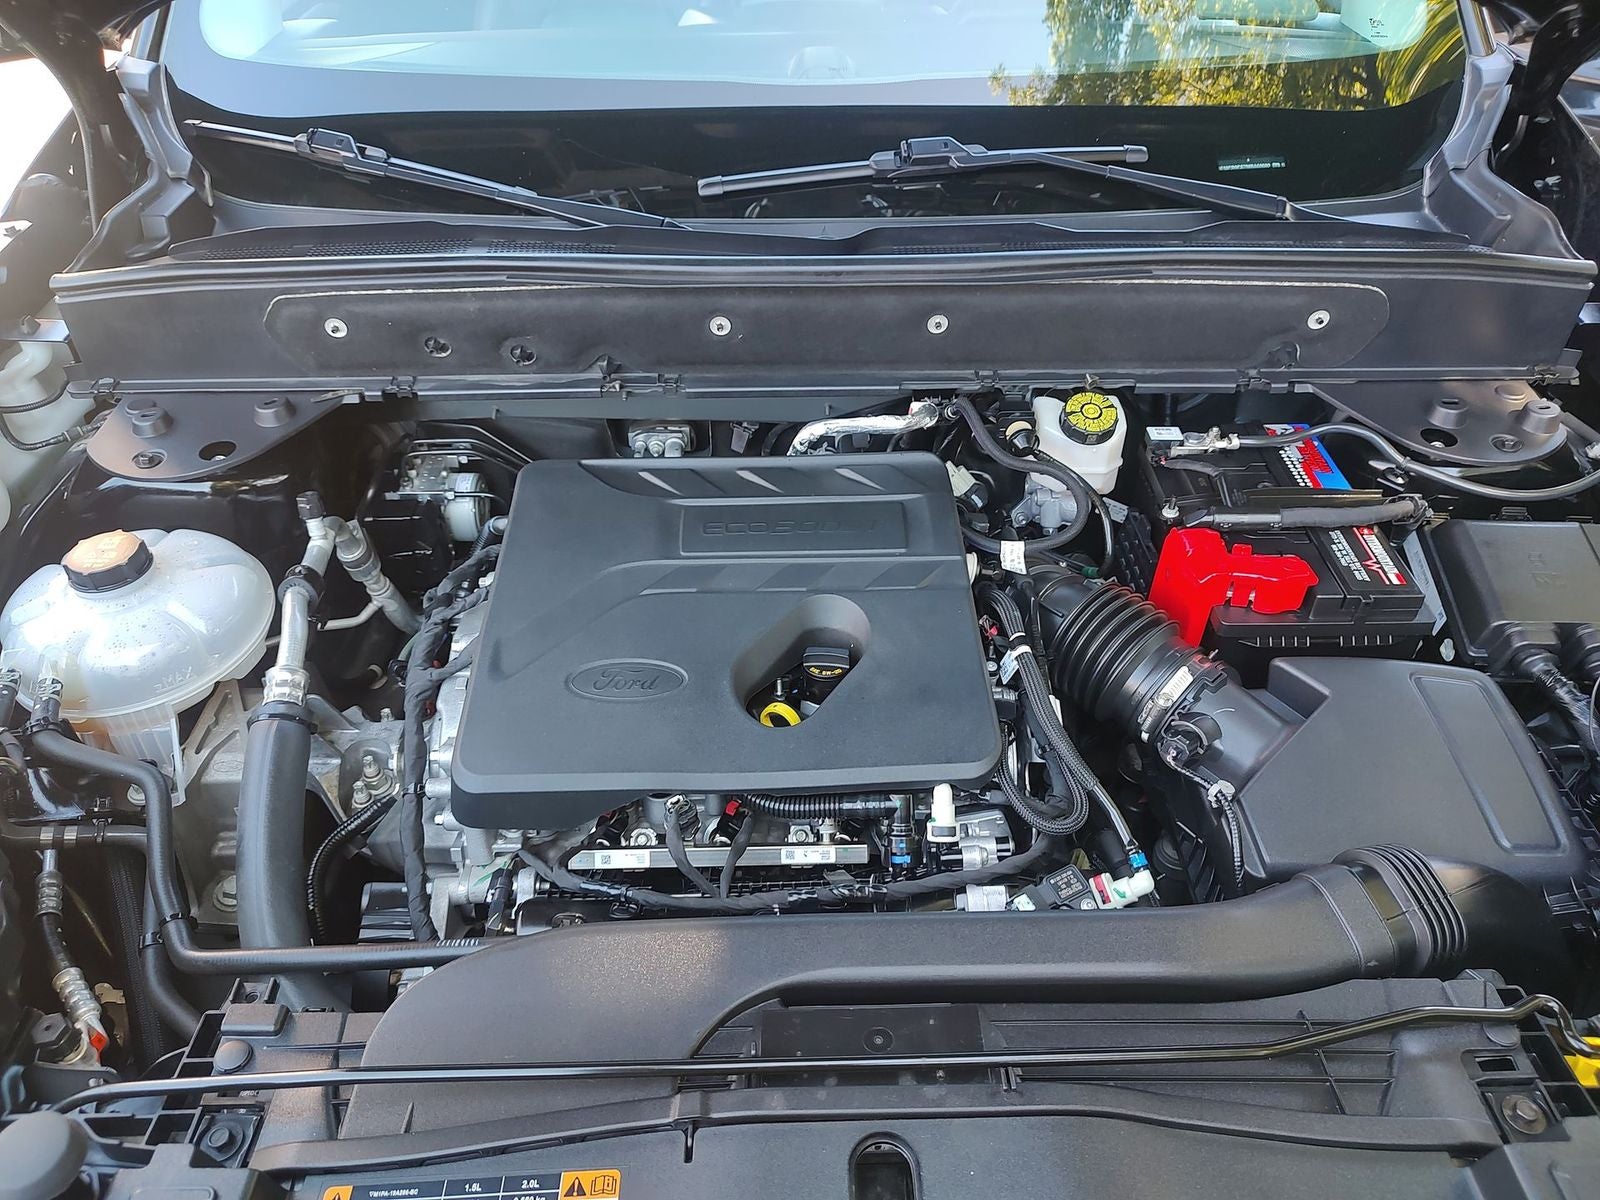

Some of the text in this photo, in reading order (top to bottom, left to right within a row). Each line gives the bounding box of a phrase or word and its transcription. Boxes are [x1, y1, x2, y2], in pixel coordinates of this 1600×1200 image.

[703, 520, 887, 537] ECOBOO
[592, 668, 660, 691] Ford
[521, 1179, 540, 1188] 2.0L
